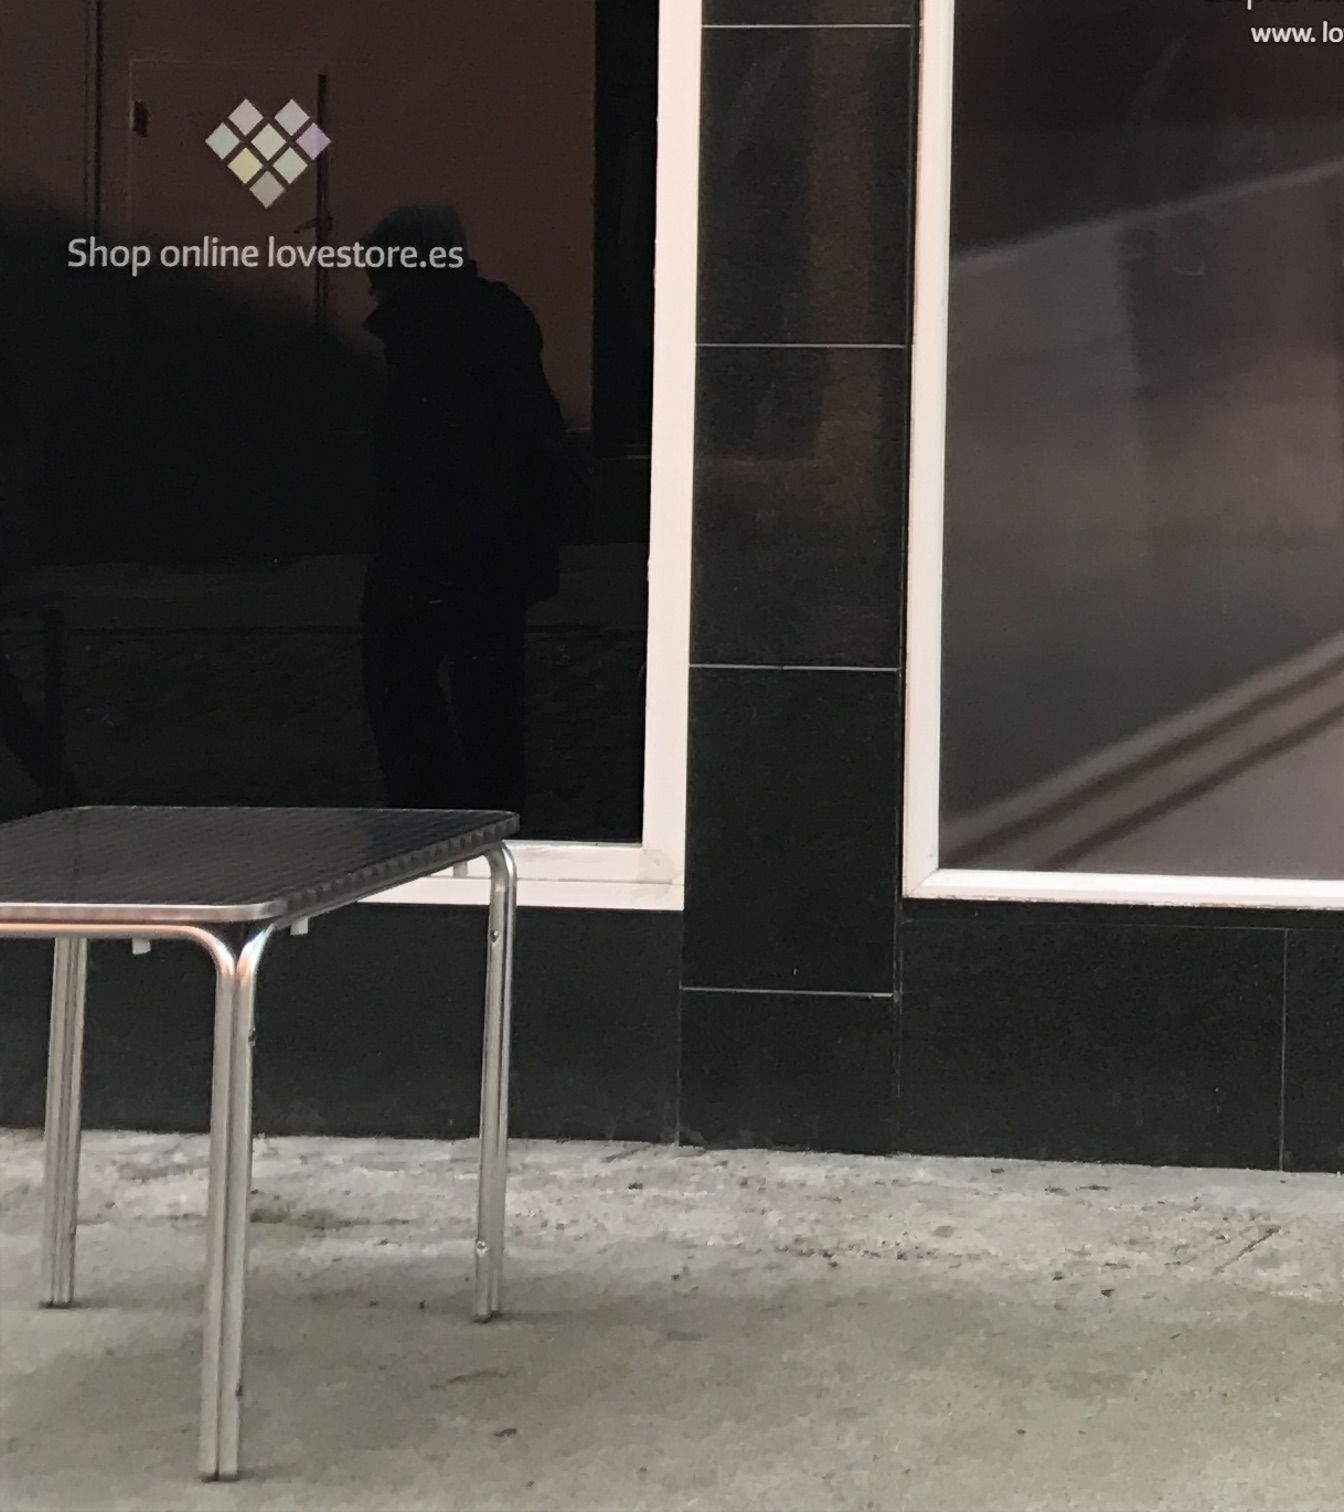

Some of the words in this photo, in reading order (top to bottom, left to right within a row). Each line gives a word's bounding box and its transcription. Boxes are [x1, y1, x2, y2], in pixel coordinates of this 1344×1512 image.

[68, 237, 151, 276] Shop
[160, 237, 258, 268] online
[268, 237, 463, 268] lovestore.es
